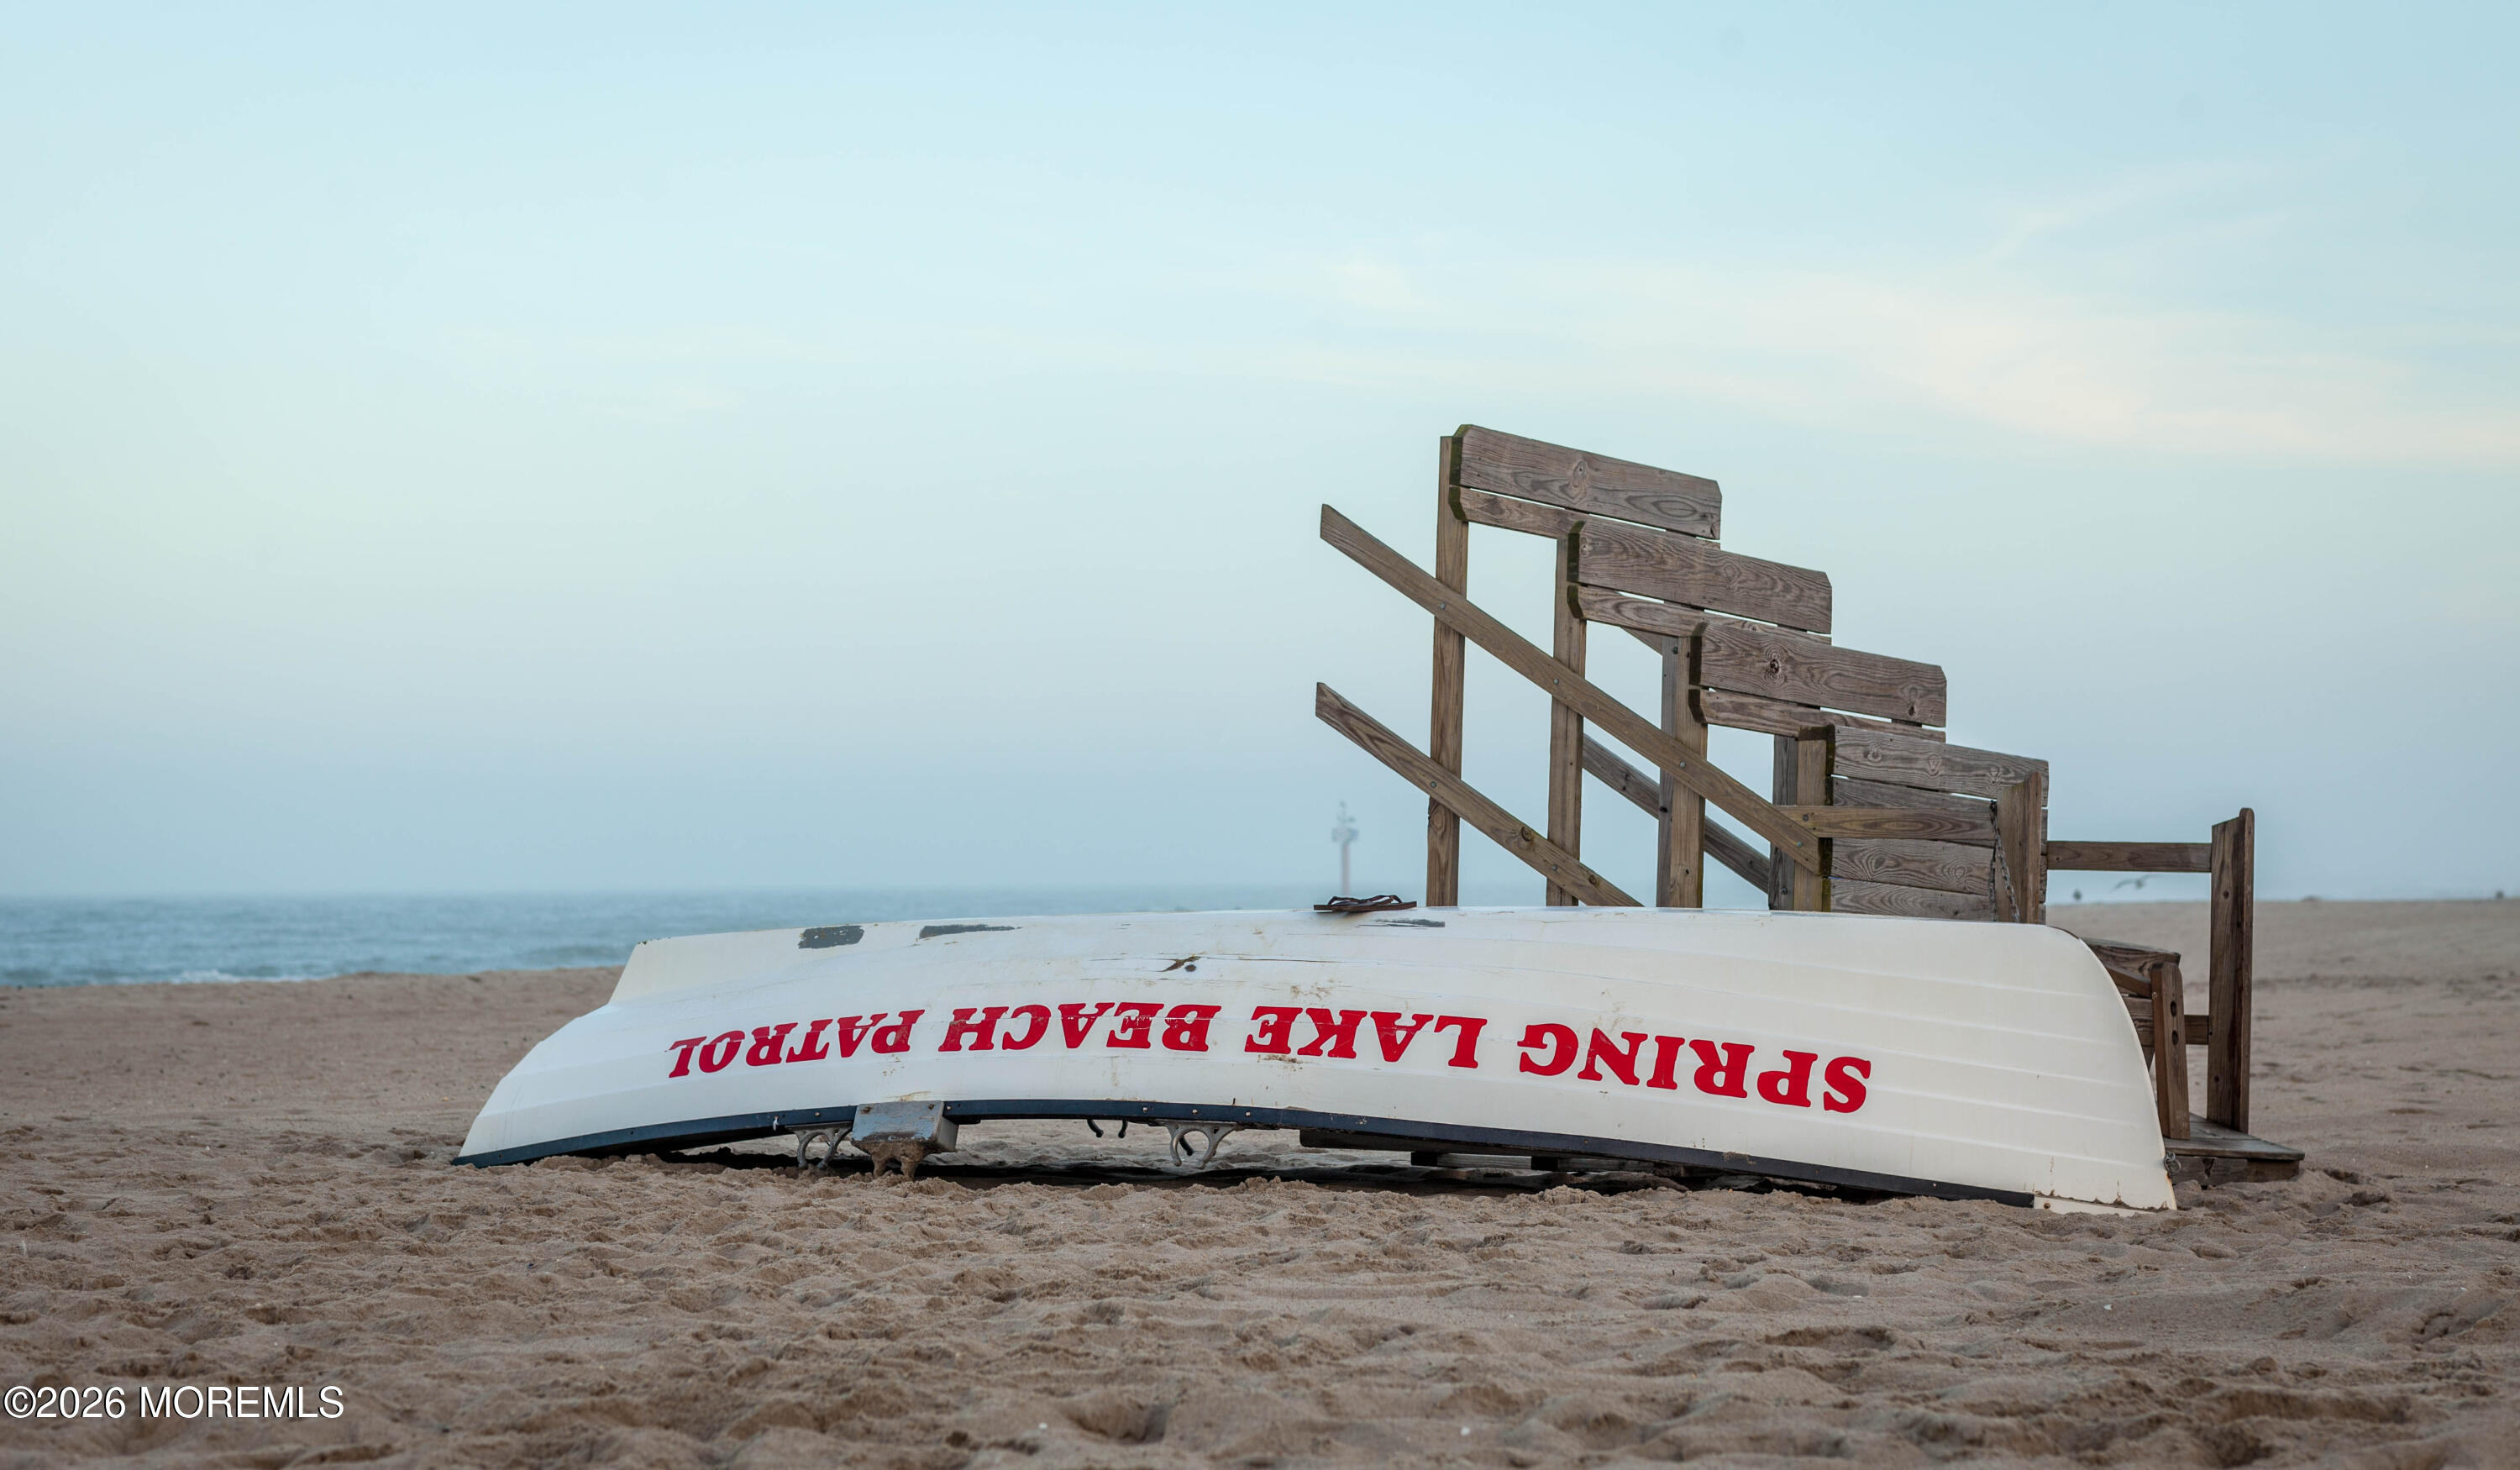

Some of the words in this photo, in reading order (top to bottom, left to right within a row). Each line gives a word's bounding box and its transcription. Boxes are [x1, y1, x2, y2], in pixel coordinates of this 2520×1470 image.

[669, 1009, 926, 1079] PATROL
[937, 1001, 1222, 1053] BEACH
[1243, 1005, 1488, 1069] LAKE
[1516, 1023, 1872, 1115] SPRING
